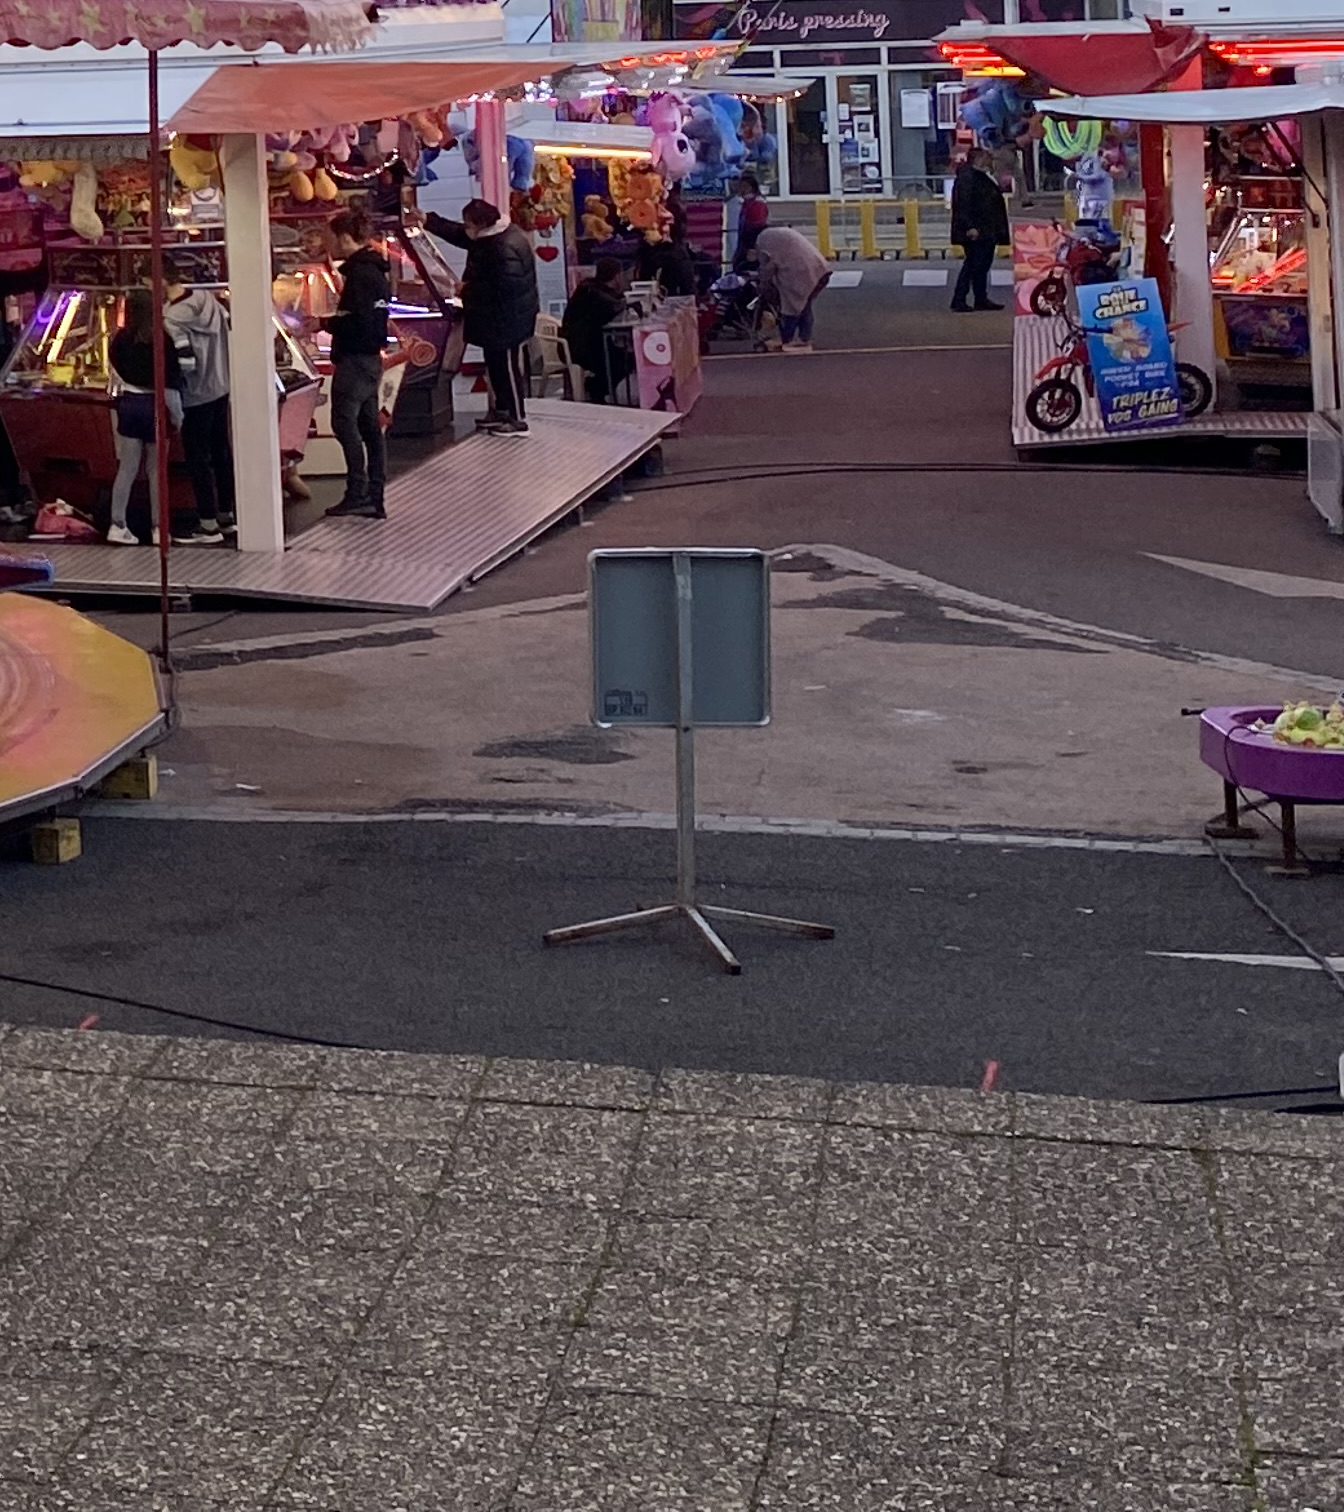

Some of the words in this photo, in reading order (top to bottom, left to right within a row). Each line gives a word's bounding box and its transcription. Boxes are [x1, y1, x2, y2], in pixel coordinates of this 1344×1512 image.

[737, 8, 799, 35] Paris
[799, 8, 890, 39] pressing
[1112, 386, 1171, 410] TRIPLEZ
